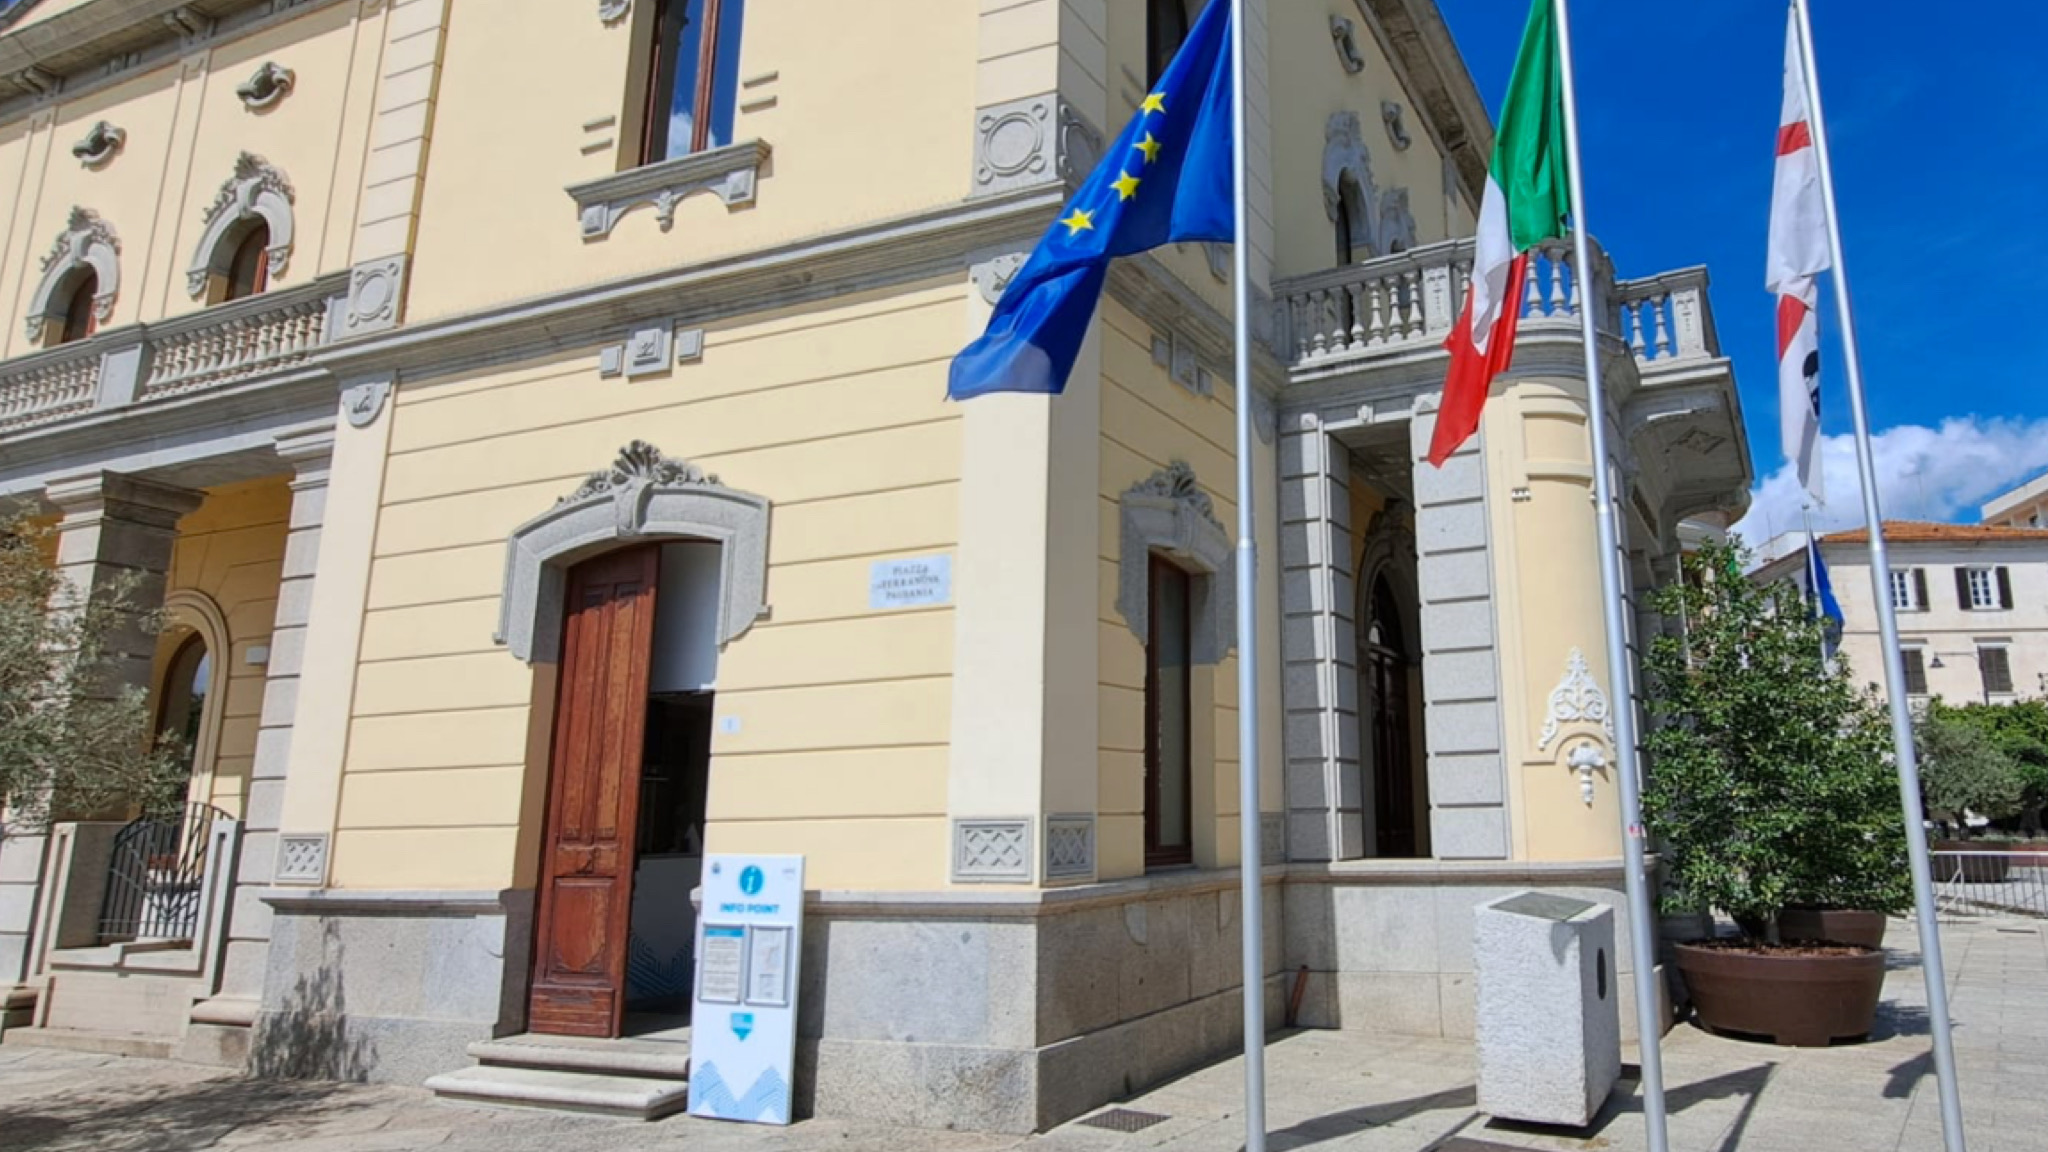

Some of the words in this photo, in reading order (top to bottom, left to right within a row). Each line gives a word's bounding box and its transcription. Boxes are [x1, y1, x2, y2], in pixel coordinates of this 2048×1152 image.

[893, 564, 928, 574] PIAZZA
[720, 903, 745, 913] INFO
[747, 904, 779, 914] POINT
